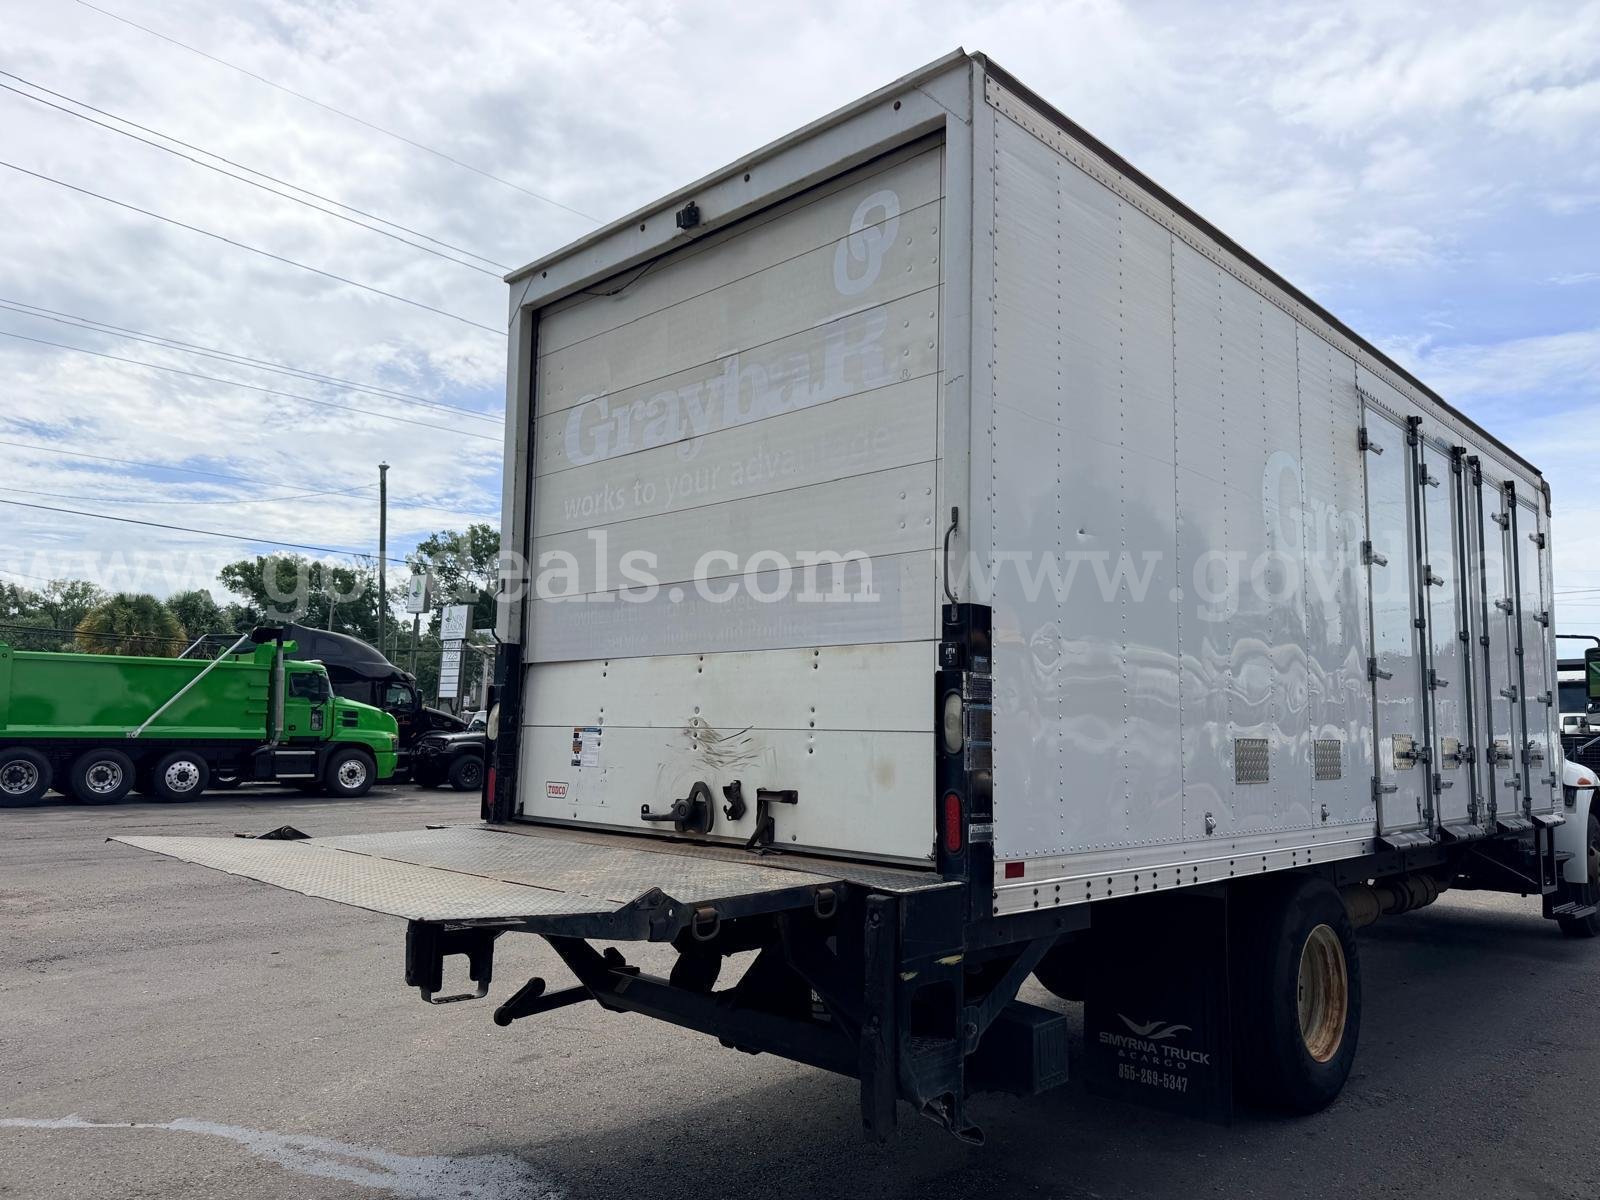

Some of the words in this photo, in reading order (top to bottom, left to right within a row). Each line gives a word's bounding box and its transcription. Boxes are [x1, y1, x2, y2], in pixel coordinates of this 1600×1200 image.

[563, 483, 625, 521] works
[631, 478, 656, 506] to
[664, 462, 721, 510] your
[1099, 1031, 1158, 1054] SMYRNA
[1160, 1044, 1211, 1066] TRUCK
[1129, 1052, 1187, 1070] CARGO
